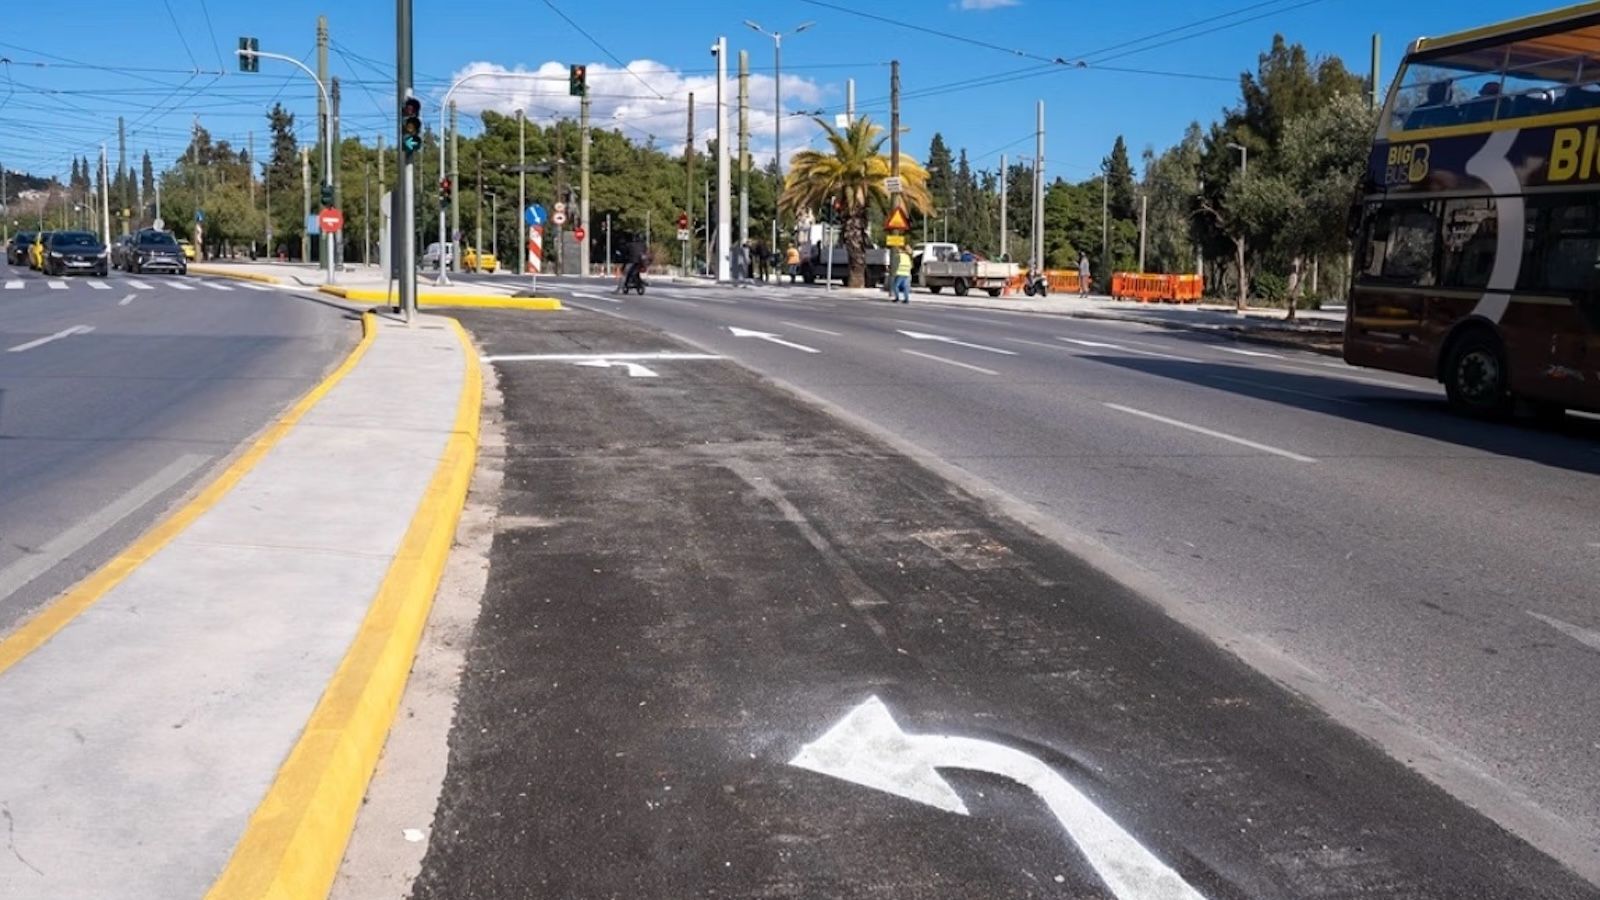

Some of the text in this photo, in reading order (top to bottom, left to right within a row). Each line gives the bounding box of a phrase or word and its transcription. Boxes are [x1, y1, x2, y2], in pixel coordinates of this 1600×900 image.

[1388, 144, 1411, 165] BIG
[1548, 125, 1600, 181] BI
[1385, 166, 1408, 184] BUS
